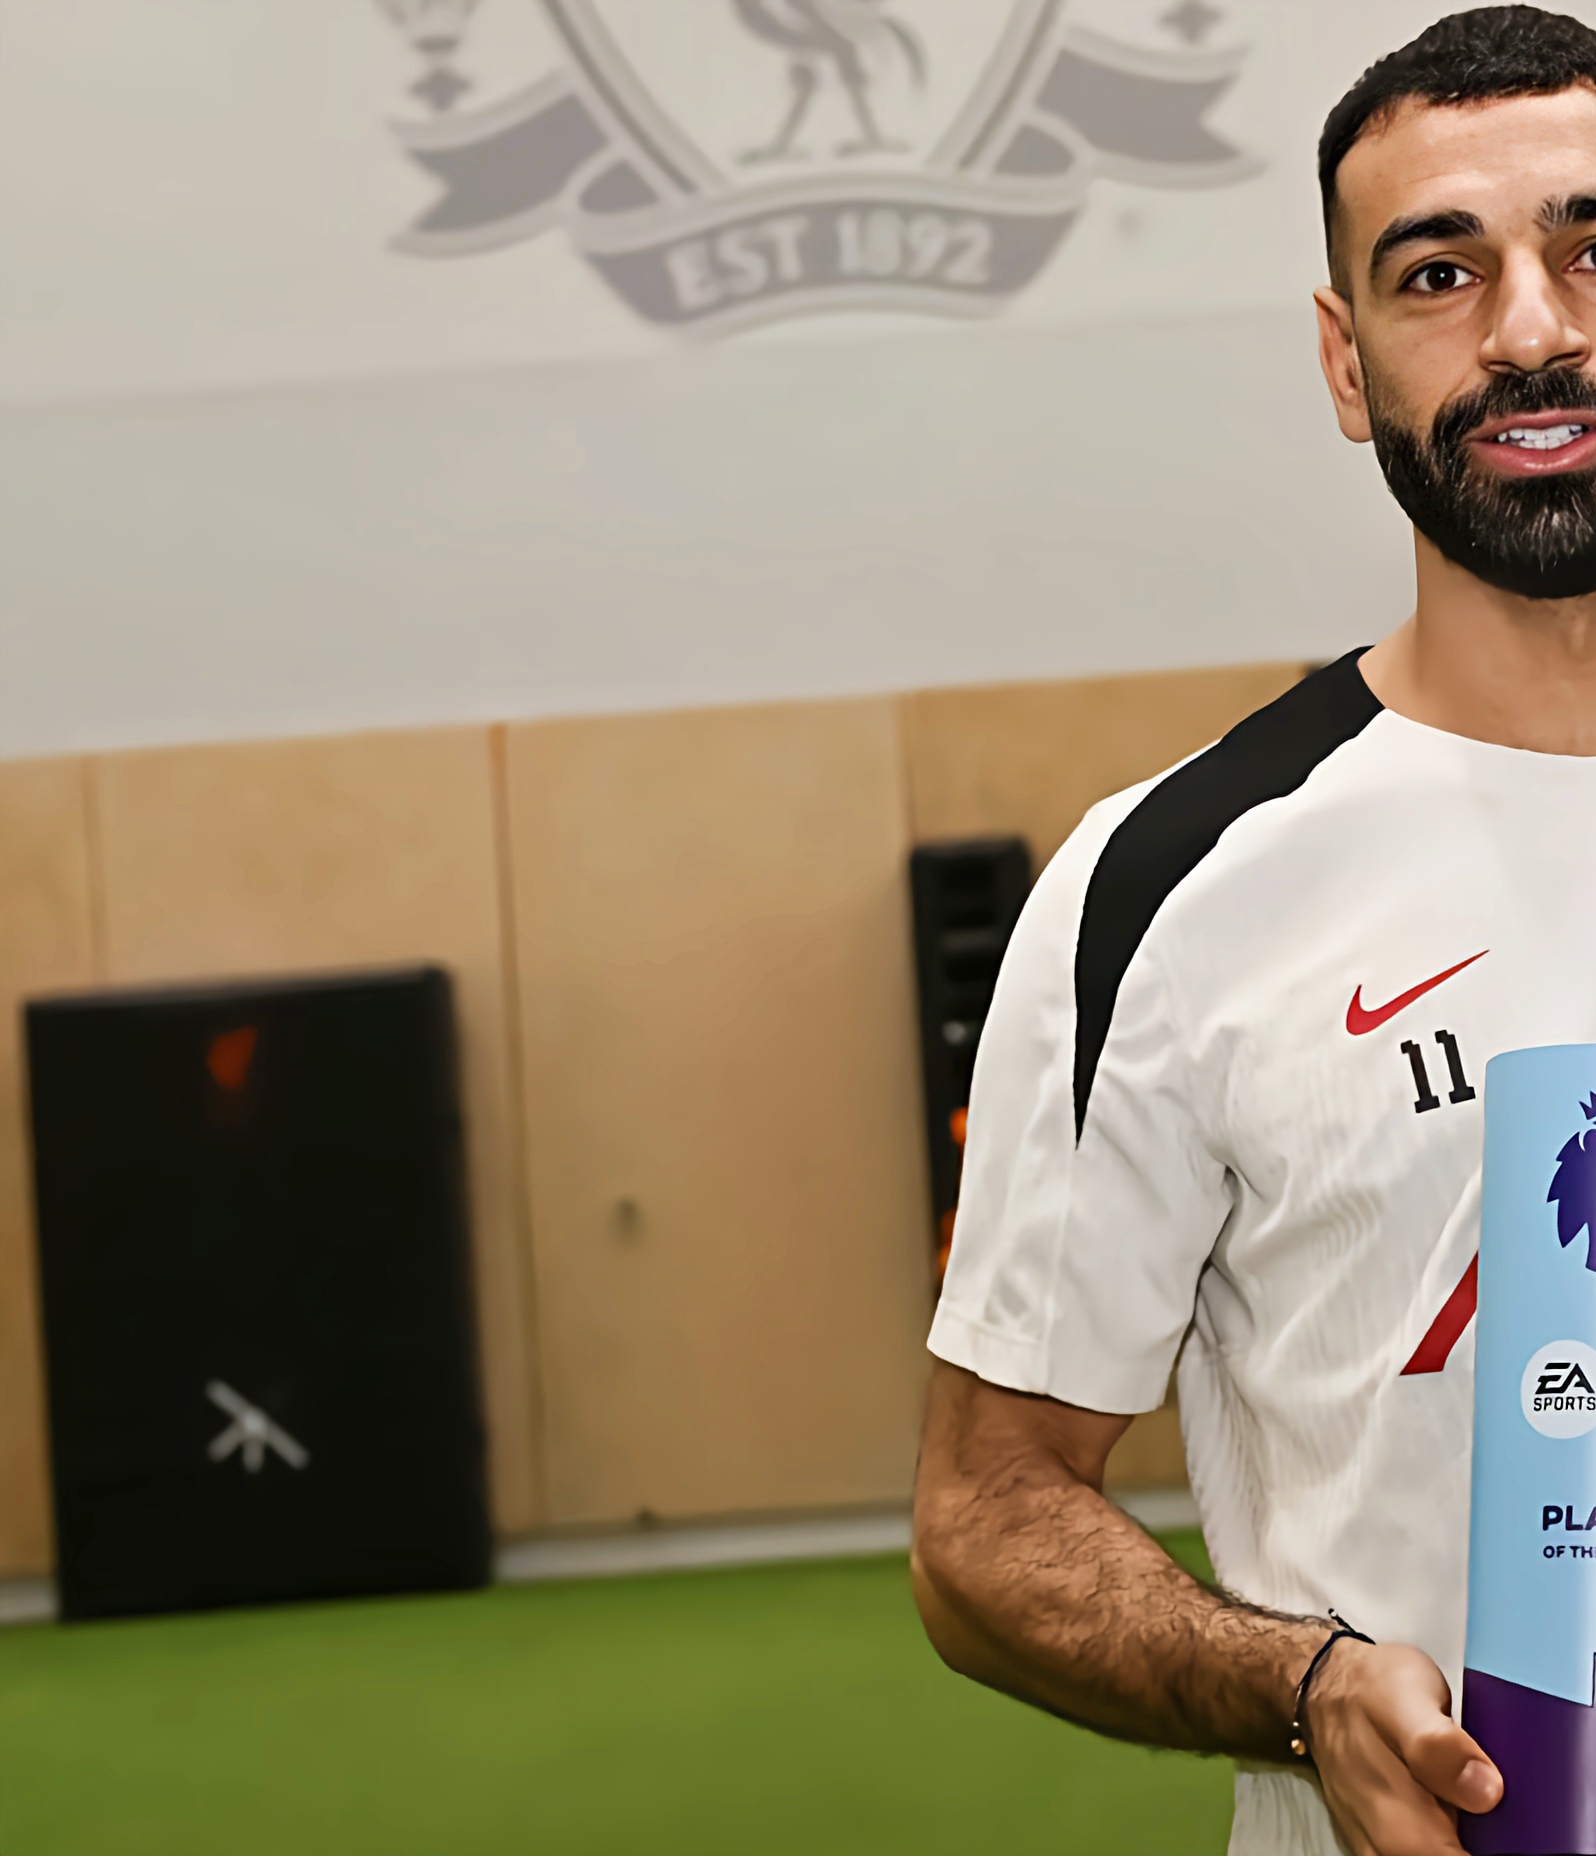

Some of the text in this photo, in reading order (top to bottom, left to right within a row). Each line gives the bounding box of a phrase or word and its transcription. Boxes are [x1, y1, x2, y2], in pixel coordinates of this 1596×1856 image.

[664, 212, 808, 311] EST
[1400, 1029, 1476, 1114] 11
[1534, 1362, 1595, 1394] EA
[1533, 1396, 1596, 1411] SPORTS
[1542, 1545, 1566, 1559] OF
